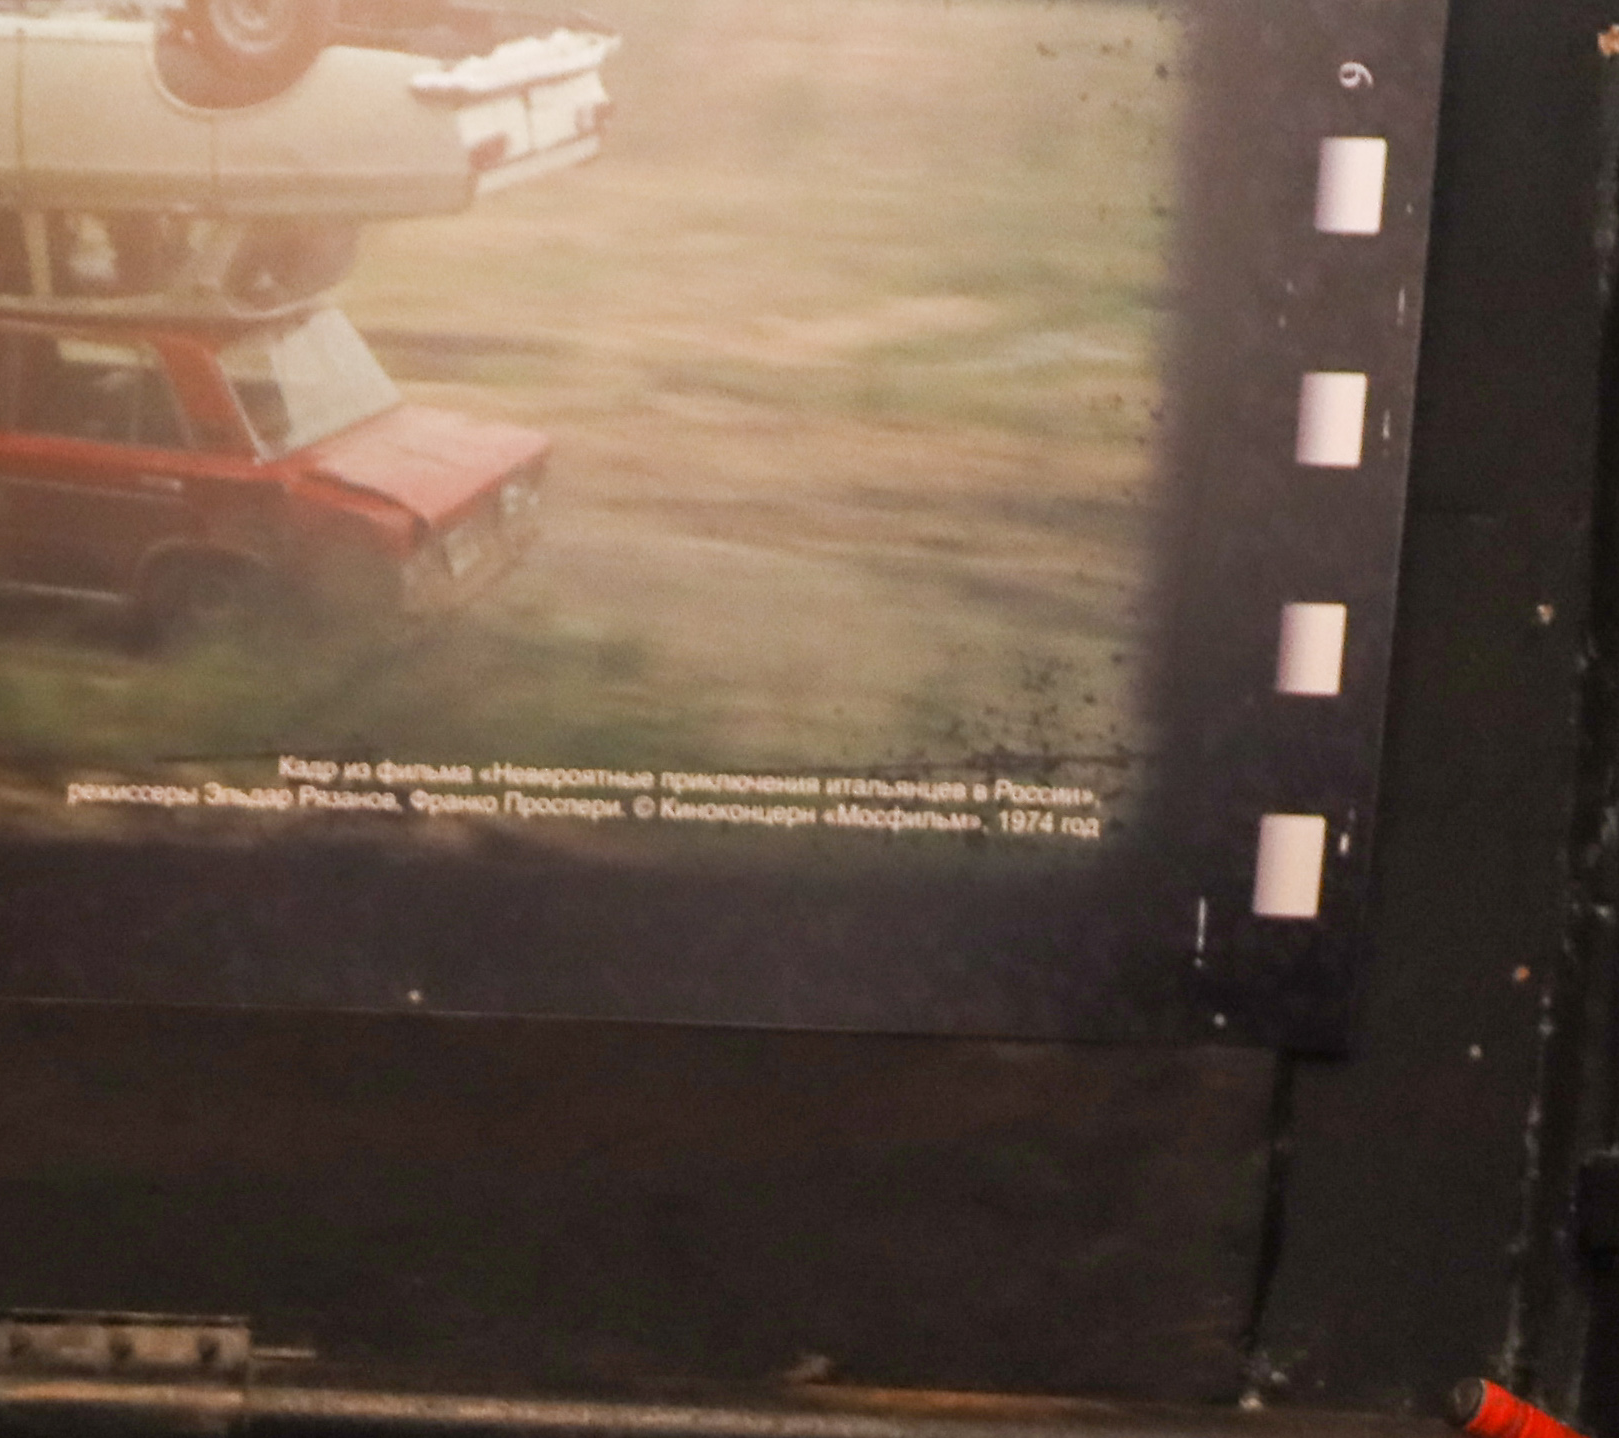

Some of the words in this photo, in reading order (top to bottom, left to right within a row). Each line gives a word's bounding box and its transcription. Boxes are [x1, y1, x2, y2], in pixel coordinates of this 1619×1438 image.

[278, 754, 338, 783] Кадр
[344, 762, 371, 779] из
[376, 760, 473, 784] фильма
[479, 761, 654, 789] «Невероятные
[661, 771, 820, 795] приключения
[973, 783, 987, 801] в
[204, 782, 294, 810] Эльдар
[410, 789, 498, 816] Франко
[661, 798, 817, 828] Киноконцерн
[999, 810, 1054, 834] 1974
[1061, 816, 1100, 839] год
